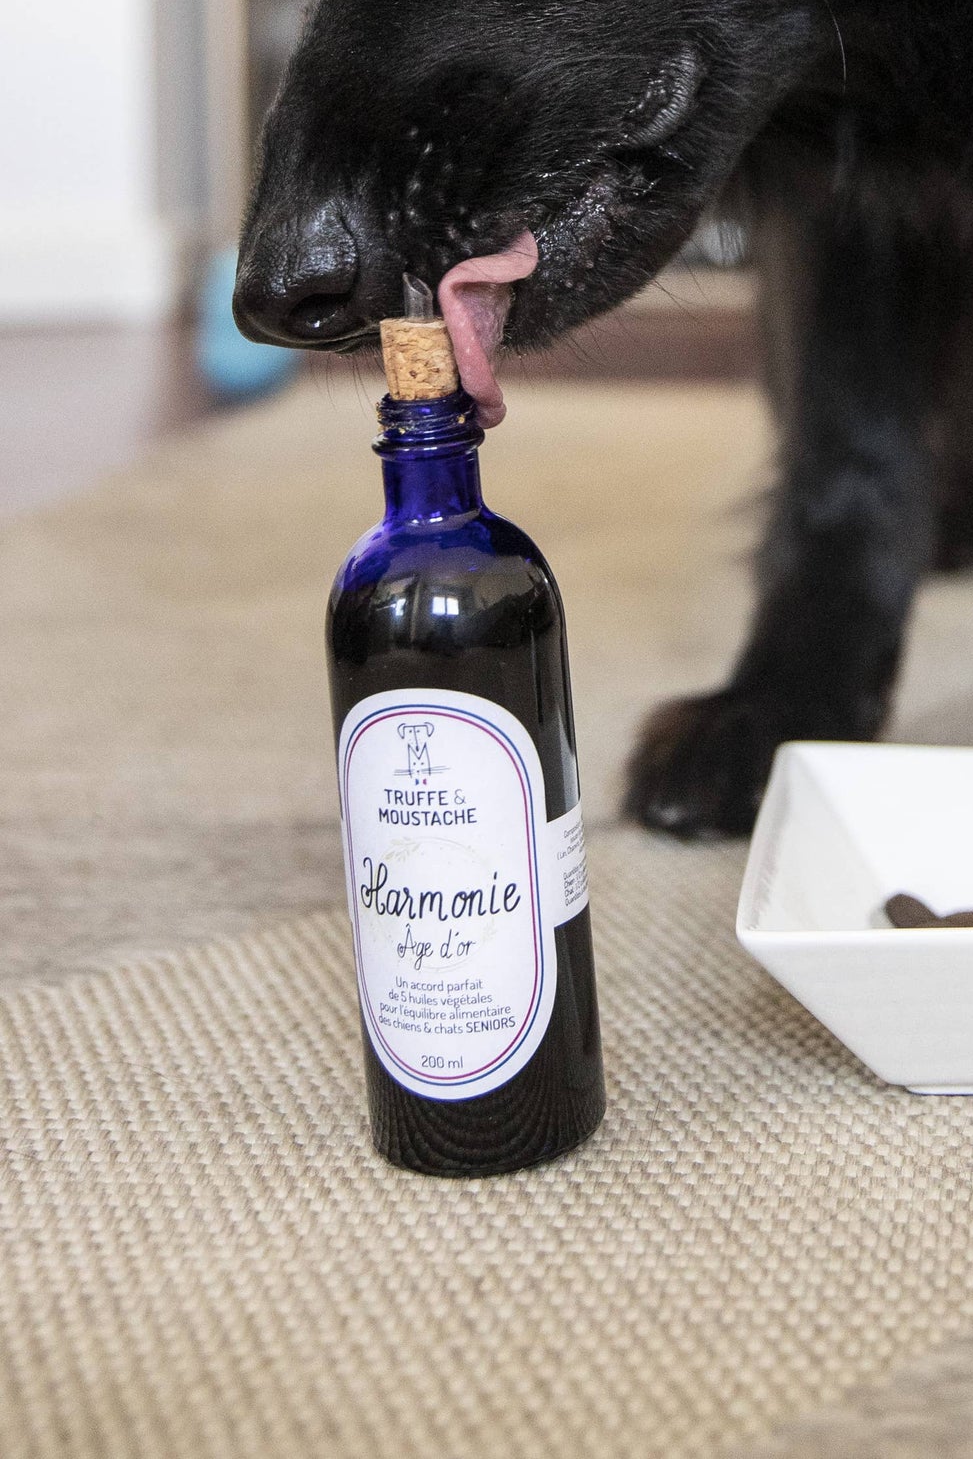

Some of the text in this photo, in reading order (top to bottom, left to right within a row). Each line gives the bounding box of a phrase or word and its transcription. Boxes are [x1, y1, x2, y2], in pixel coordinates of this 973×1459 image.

[384, 789, 467, 806] TRUFFE &
[378, 808, 477, 826] MOUSTACHE
[361, 857, 521, 921] Harmonie
[397, 924, 476, 970] Âge d'or
[395, 976, 483, 994] Un accord parfait
[389, 989, 492, 1008] de 5 huiles végétales
[380, 1002, 511, 1020] pour l'équilibre alimentaire
[378, 1015, 516, 1034] des chiens & chats SENIORS
[421, 1055, 463, 1068] 200 ml
